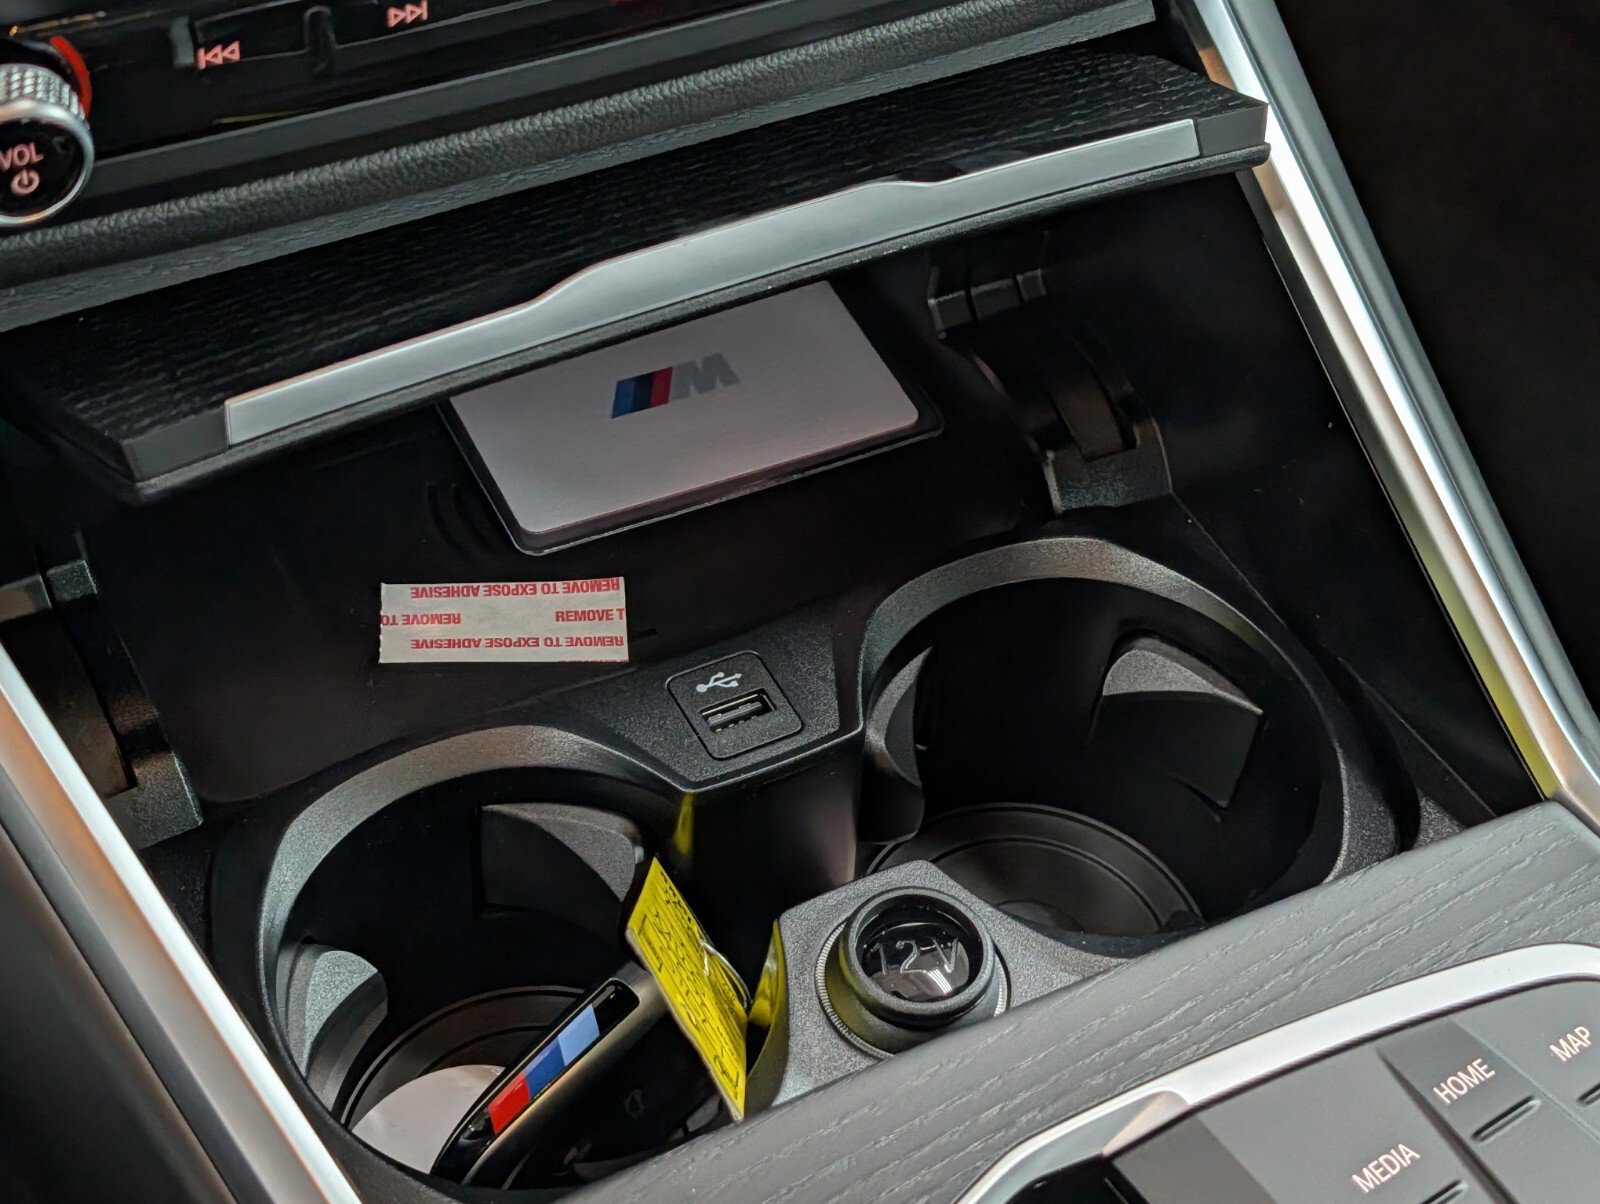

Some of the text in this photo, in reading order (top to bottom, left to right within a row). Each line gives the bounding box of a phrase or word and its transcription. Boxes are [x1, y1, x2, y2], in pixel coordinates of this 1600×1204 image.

[0, 142, 44, 170] VOL
[411, 578, 620, 599] REMOVE TO EXPOSE ADHESIVE
[402, 613, 461, 625] REMOVE
[555, 609, 614, 622] REMOVE
[411, 636, 624, 649] REMOVE TO EXPOSE ADHESIVE
[870, 938, 959, 975] 12V
[1550, 1026, 1591, 1062] MAP
[1433, 1058, 1496, 1104] HOME
[1352, 1144, 1421, 1193] MEDIA
